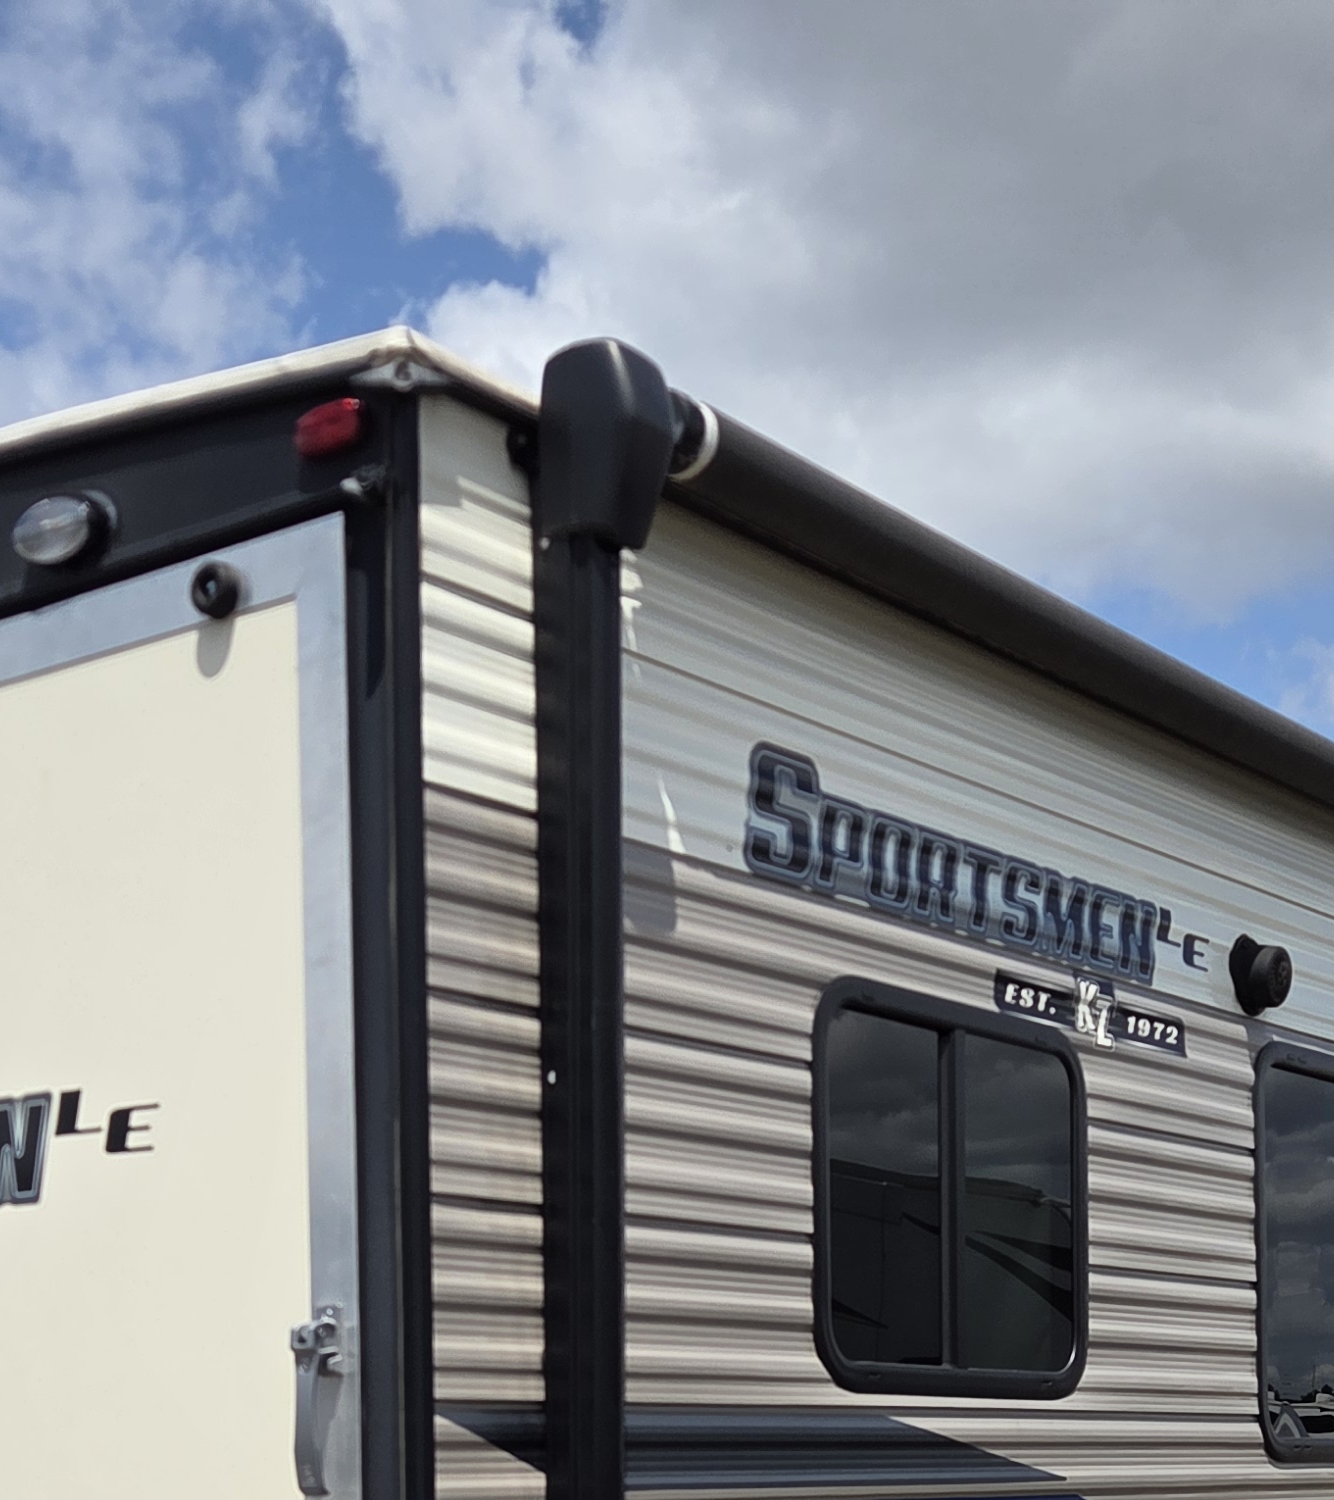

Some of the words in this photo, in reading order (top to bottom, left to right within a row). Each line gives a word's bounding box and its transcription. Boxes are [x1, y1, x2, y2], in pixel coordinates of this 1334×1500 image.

[743, 741, 1158, 986] SPORTSMEN
[1157, 906, 1210, 973] LE
[1003, 983, 1058, 1016] EST.
[1073, 975, 1117, 1050] KZ
[1125, 1015, 1179, 1045] 1972
[55, 1088, 160, 1154] LE
